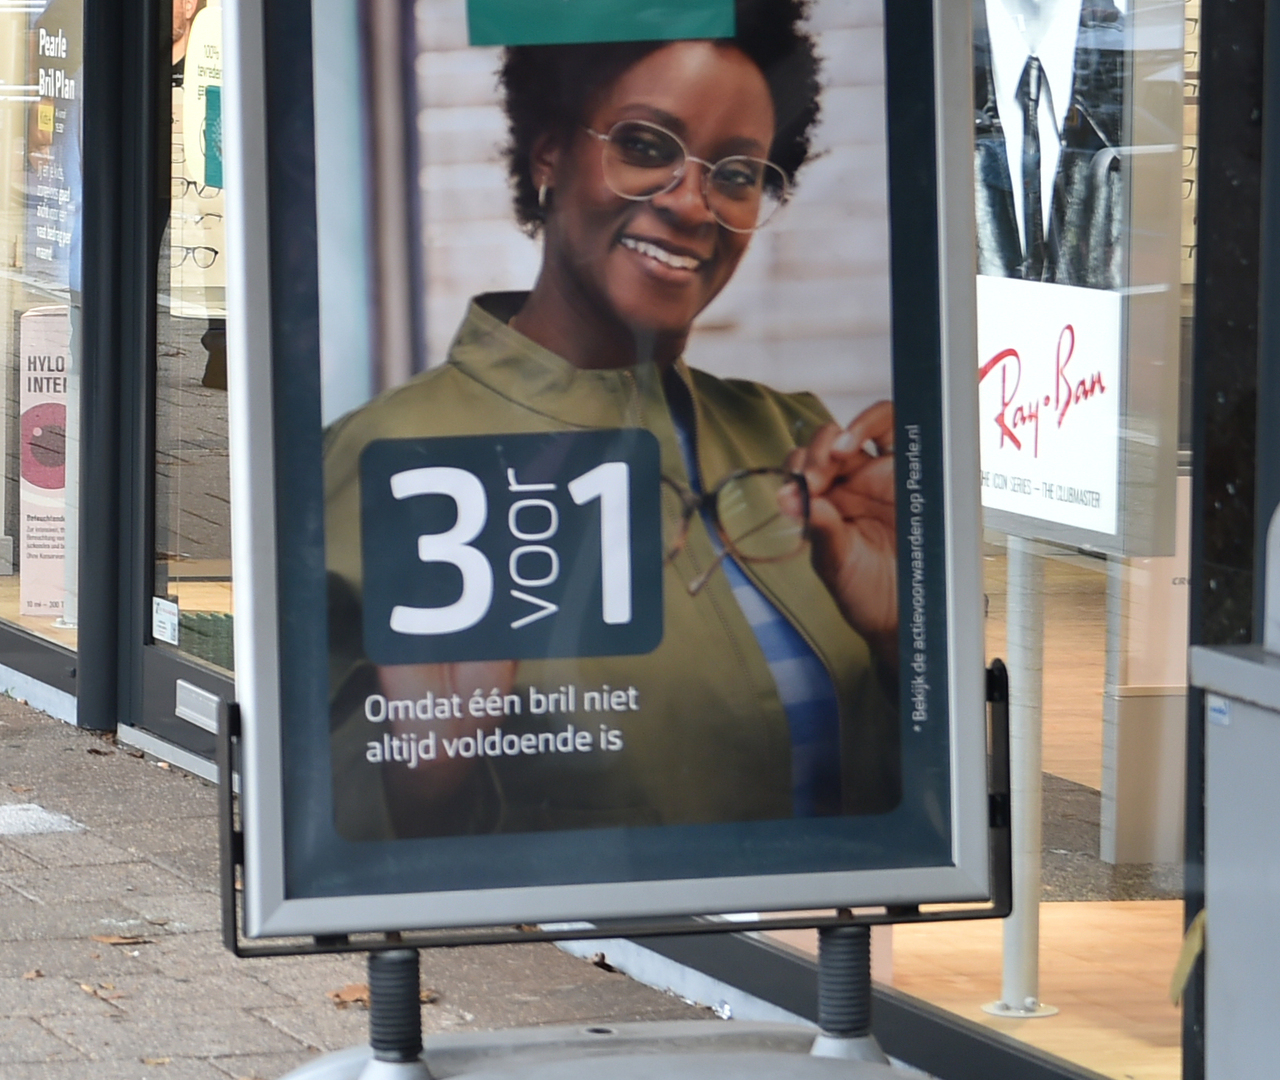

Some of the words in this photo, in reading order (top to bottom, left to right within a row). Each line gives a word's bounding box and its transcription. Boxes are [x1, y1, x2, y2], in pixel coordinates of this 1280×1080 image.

[39, 28, 67, 58] Pearle
[38, 68, 55, 97] Bril
[55, 70, 75, 100] Plan
[27, 355, 64, 373] HYLO
[905, 424, 922, 490] Pearle.nl
[909, 492, 925, 515] op
[1009, 476, 1032, 495] SERIES
[1042, 482, 1054, 499] THE
[1056, 484, 1101, 508] CLUBMASTER
[389, 466, 494, 637] 3
[507, 467, 560, 629] voor
[567, 462, 633, 625] 1
[909, 517, 925, 649] actievoorwaarden
[913, 650, 925, 671] de
[364, 691, 462, 723] Omdat
[468, 689, 522, 717] één
[529, 685, 575, 715] bril
[584, 685, 640, 711] niet
[911, 674, 931, 721] Bekijk
[365, 731, 437, 769] altijd
[443, 726, 593, 758] voldoende
[599, 724, 624, 751] is
